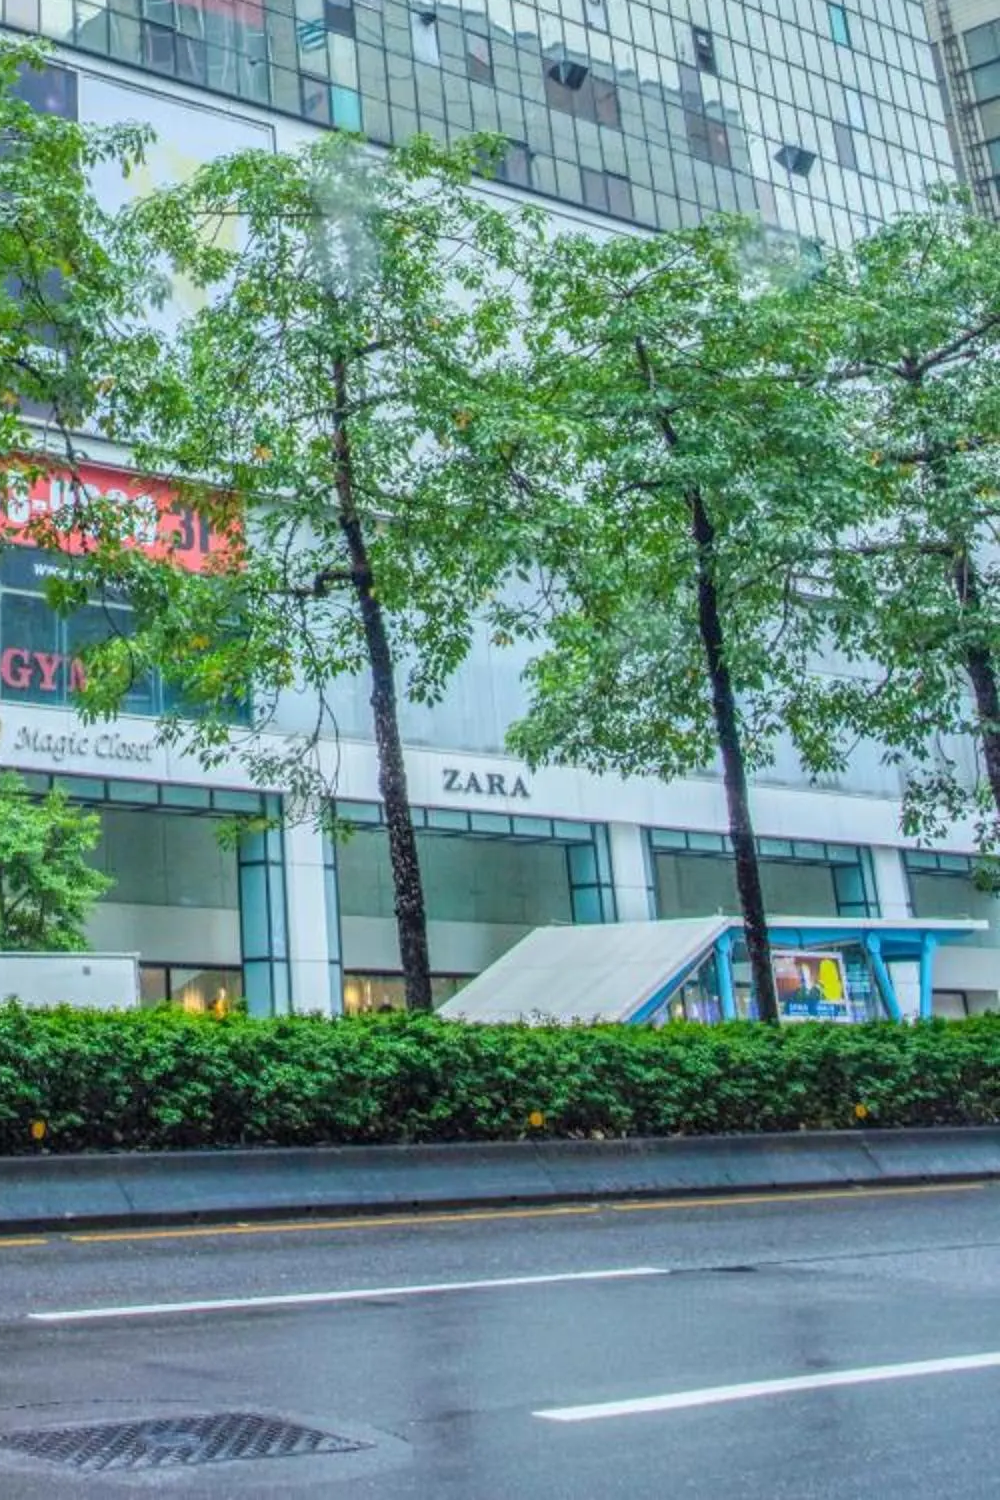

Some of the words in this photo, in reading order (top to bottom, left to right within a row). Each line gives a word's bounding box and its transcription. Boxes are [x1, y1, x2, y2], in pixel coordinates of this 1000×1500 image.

[13, 725, 90, 762] Magic
[93, 731, 154, 762] Closet
[442, 767, 531, 798] ZARA
